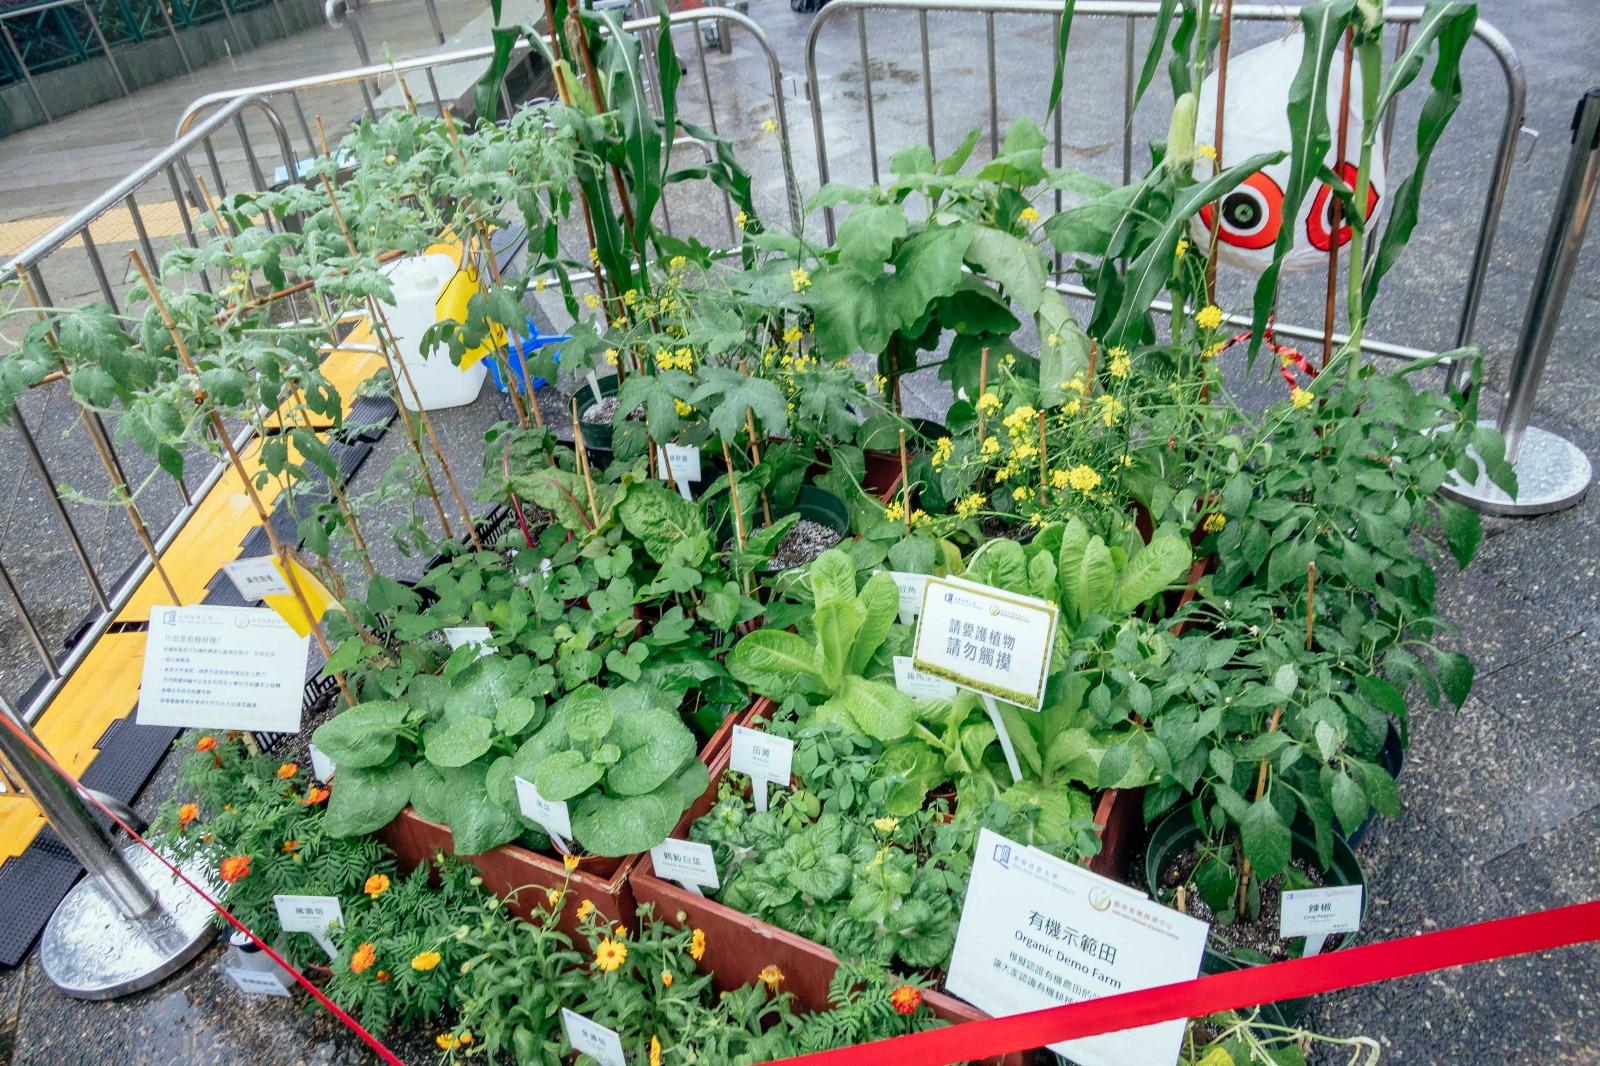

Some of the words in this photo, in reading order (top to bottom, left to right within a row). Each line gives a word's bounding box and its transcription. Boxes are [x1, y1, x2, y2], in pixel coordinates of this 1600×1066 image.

[946, 636, 1012, 672] 請勿觸摸
[948, 618, 1016, 651] 請愛護植物
[1014, 929, 1054, 957] Organic
[1055, 948, 1089, 974] Demo
[1092, 966, 1122, 990] Farm
[1027, 909, 1118, 965] 有機示範田
